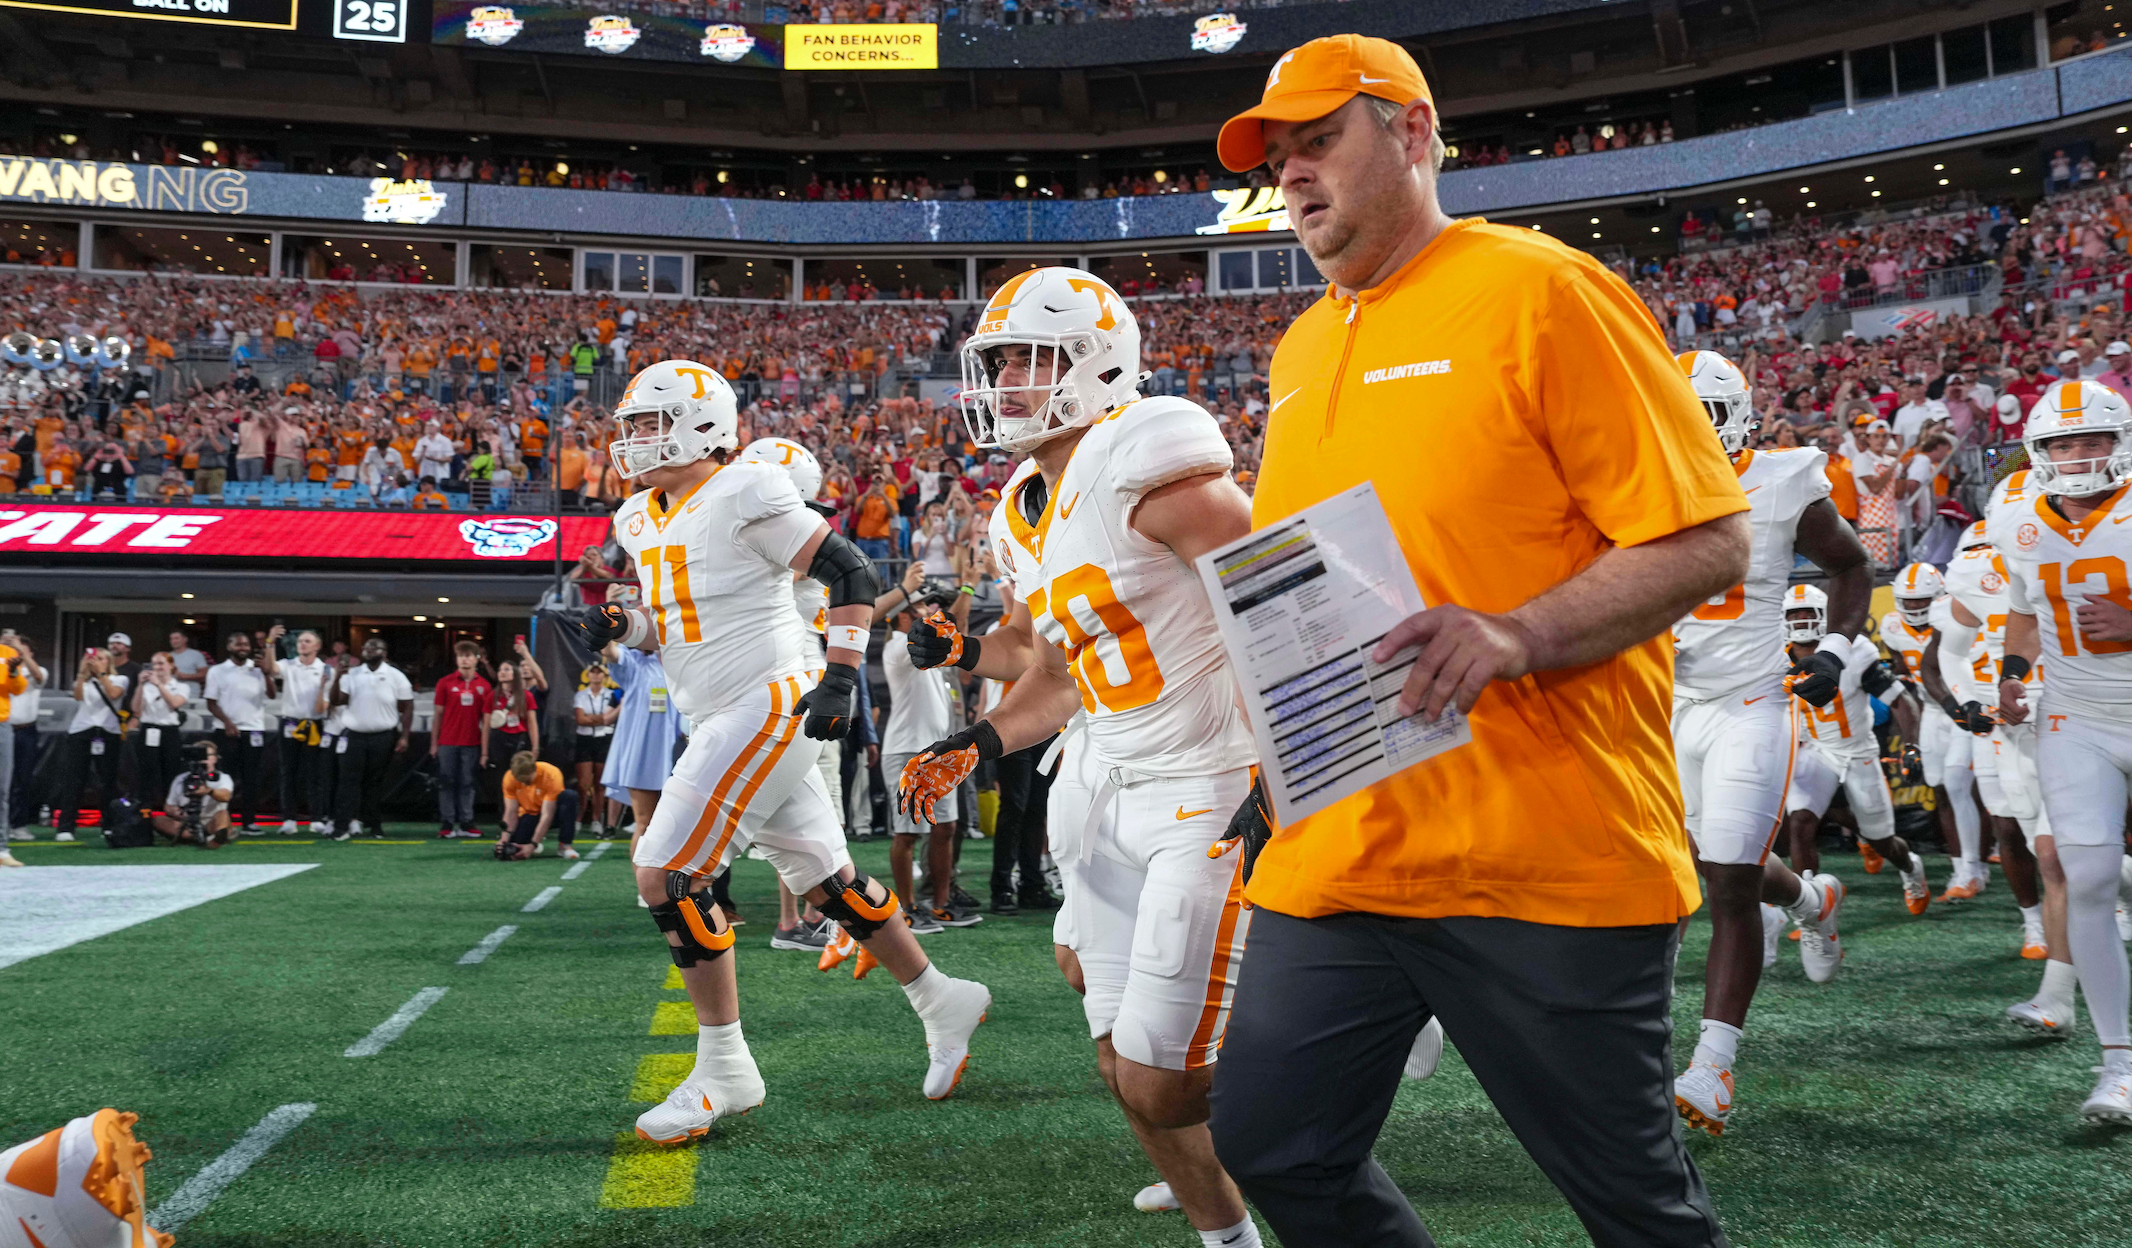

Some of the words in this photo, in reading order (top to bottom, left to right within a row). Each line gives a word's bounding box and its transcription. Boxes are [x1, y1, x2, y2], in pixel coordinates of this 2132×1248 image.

[194, 0, 229, 13] ON
[345, 0, 396, 32] 25
[803, 35, 835, 45] FAN
[841, 34, 922, 45] BEHAVIOR
[812, 51, 914, 61] CONCERNS...
[1066, 279, 1120, 334] T
[978, 321, 1003, 334] VOLS
[1363, 359, 1451, 384] VOLUNTEERS
[674, 367, 714, 401] T
[2058, 418, 2083, 427] VOLS
[775, 442, 803, 466] T
[0, 510, 223, 547] ATE
[658, 516, 667, 531] T
[2068, 528, 2084, 543] T
[1031, 534, 1041, 559] T
[640, 545, 702, 645] 71
[846, 629, 858, 641] T
[2047, 714, 2068, 732] T
